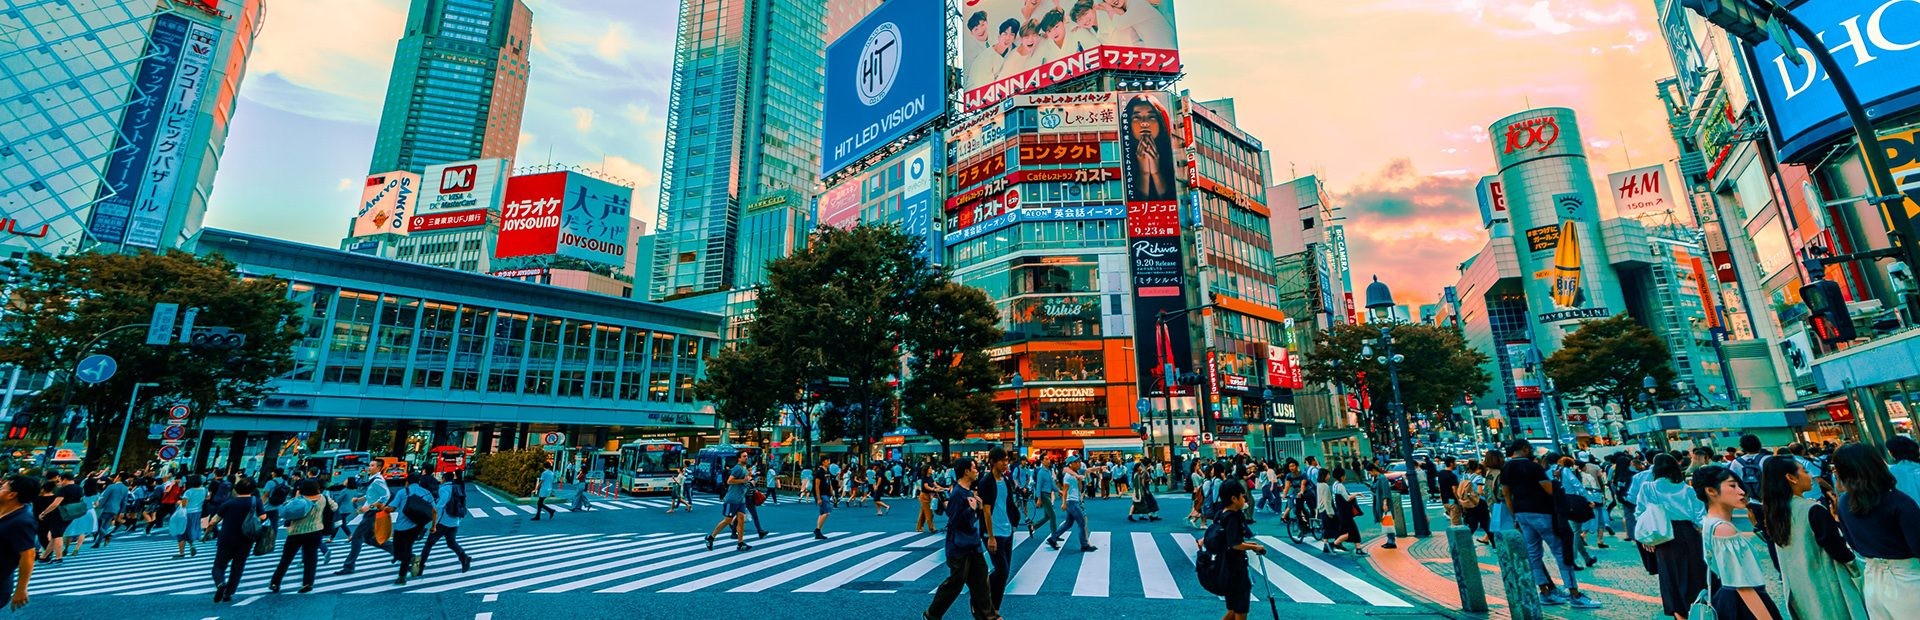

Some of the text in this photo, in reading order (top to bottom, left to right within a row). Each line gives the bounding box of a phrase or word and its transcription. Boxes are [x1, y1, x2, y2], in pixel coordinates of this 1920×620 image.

[1104, 50, 1176, 67] ワナワン
[1029, 93, 1111, 104] しゃぶしゃぶバイキング
[1065, 108, 1114, 124] しゃぶ葉
[834, 94, 926, 160] HIT LED VISION
[1503, 121, 1559, 155] 109
[948, 147, 957, 158] 9F
[1020, 145, 1098, 160] コンタクト
[443, 168, 473, 190] DC
[959, 155, 1005, 186] プライス
[1075, 168, 1112, 182] ガスト
[984, 177, 1008, 198] ガスト
[1618, 170, 1659, 199] H&M
[392, 177, 412, 229] SANKYO
[441, 198, 477, 209] MasterCard
[505, 197, 561, 218] カラオケ
[565, 185, 630, 221] 大声
[974, 199, 1003, 224] ガスト
[1129, 202, 1177, 215] ユリゴコロ
[428, 214, 481, 226] 三菱東京UFJ銀行
[1025, 207, 1124, 219] AEON 英会話イーオン
[502, 215, 559, 232] JOYSOUND
[560, 232, 625, 256] JOYSOUND
[1132, 240, 1178, 257] Rihwa
[1335, 229, 1349, 272] BIC CAMERA
[1136, 259, 1154, 267] 9.20
[1557, 278, 1576, 290] BIG
[1540, 309, 1608, 321] MAYBELLINE
[1040, 387, 1094, 398] L'OCCITANE
[1272, 402, 1296, 418] LUSH
